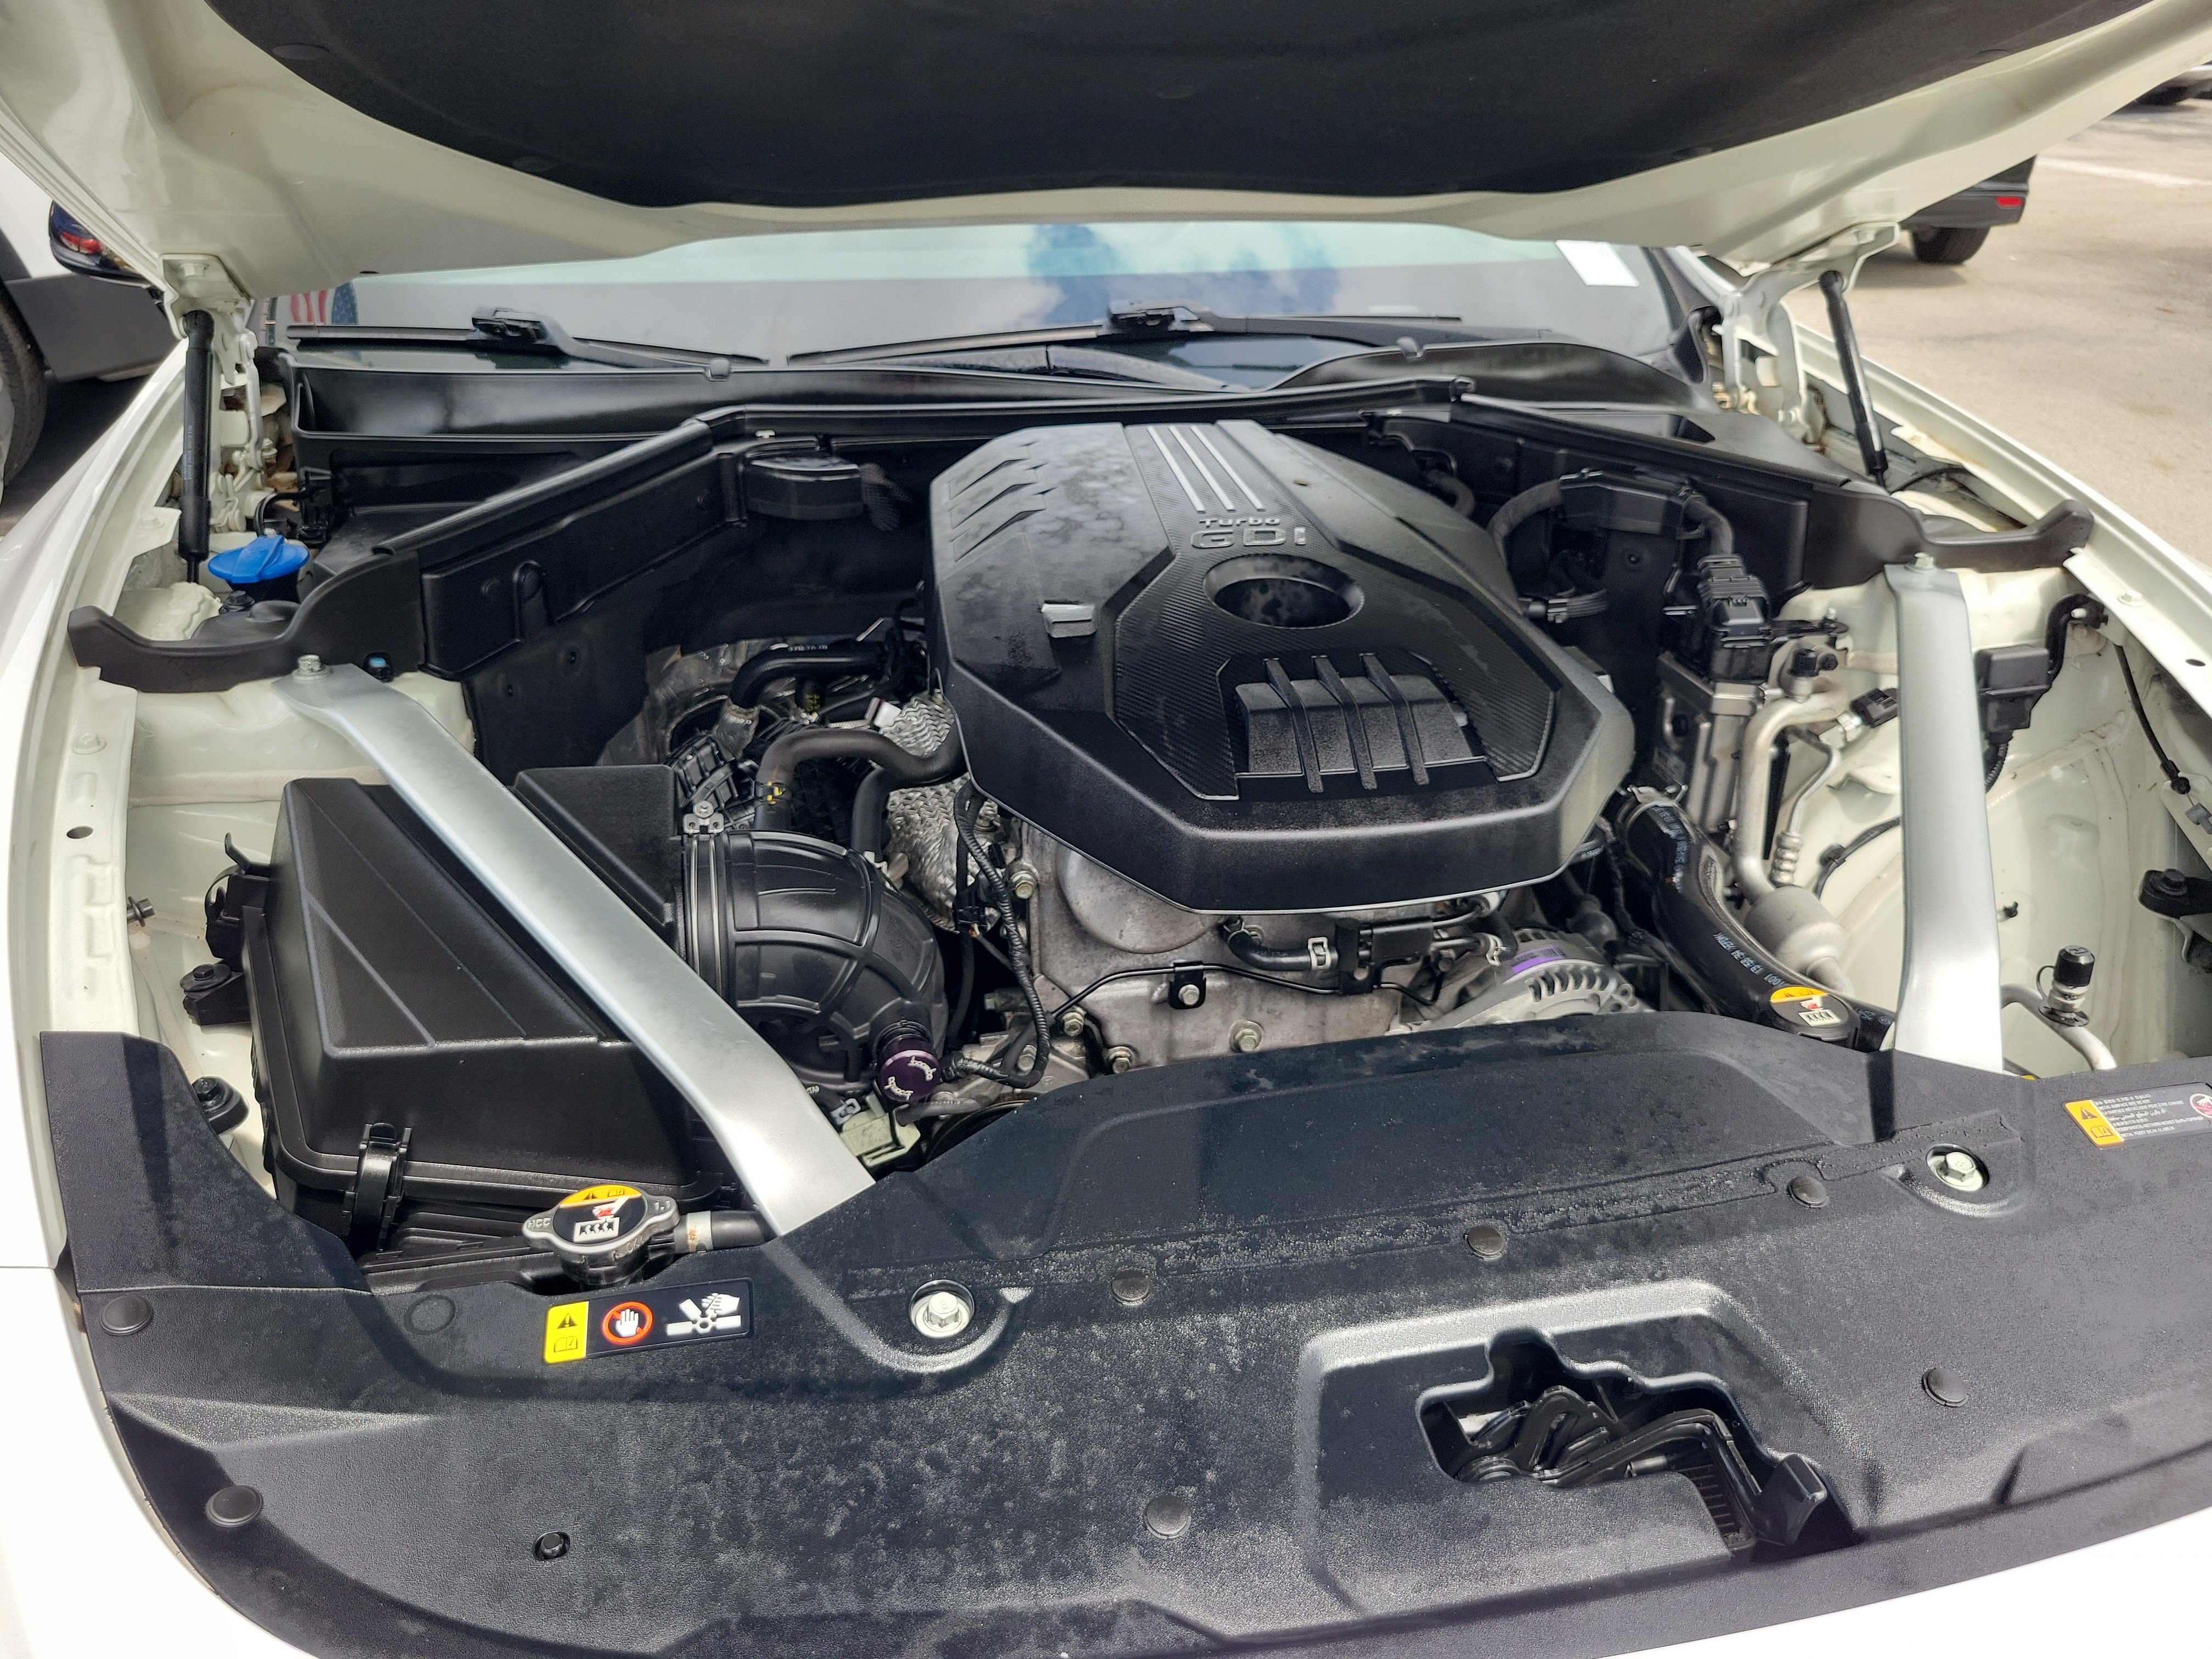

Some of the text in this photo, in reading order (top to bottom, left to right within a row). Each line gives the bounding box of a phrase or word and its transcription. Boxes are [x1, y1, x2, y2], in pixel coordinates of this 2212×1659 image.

[1199, 517, 1280, 528] Turbo
[1190, 527, 1307, 549] GDI
[527, 1216, 551, 1229] HCC
